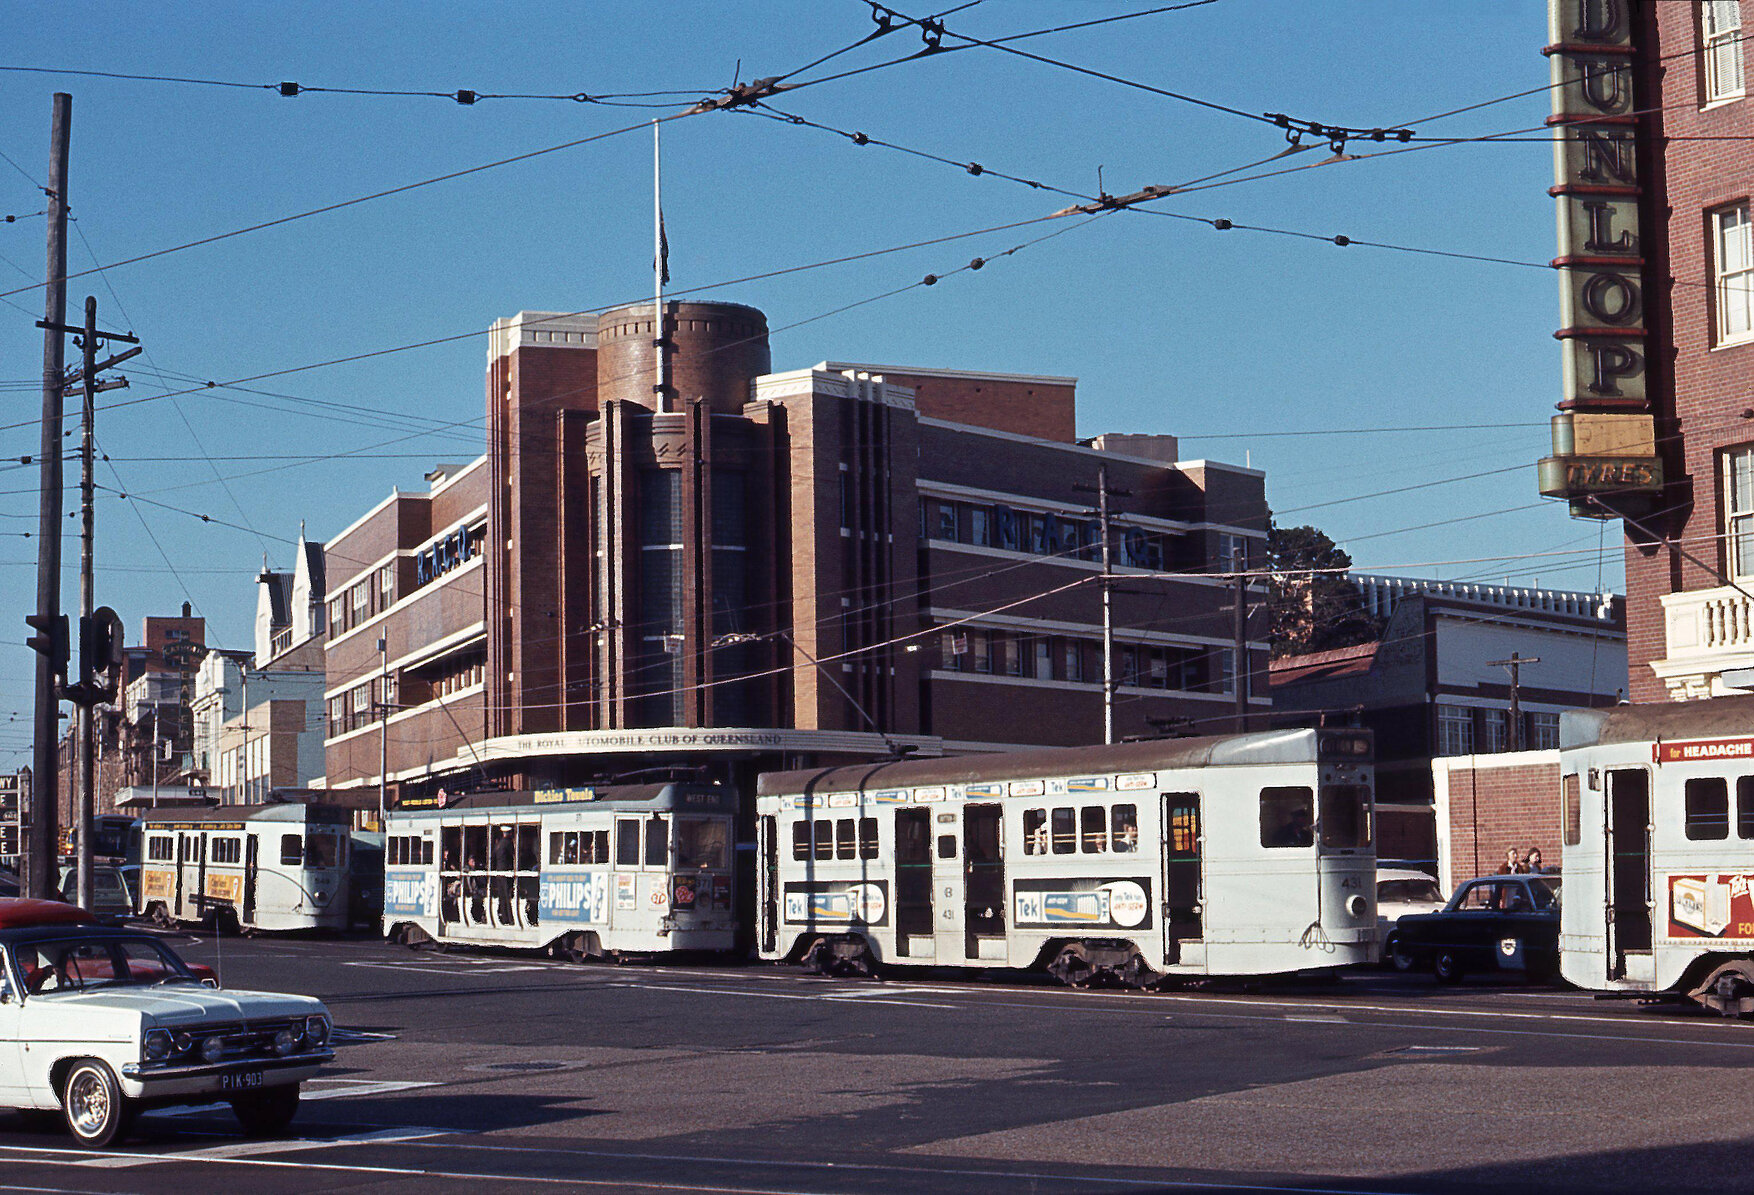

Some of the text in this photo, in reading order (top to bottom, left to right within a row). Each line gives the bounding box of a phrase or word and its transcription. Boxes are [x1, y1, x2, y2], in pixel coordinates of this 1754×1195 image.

[1573, 0, 1637, 396] DUNLOP
[1566, 462, 1654, 484] TYRES
[518, 741, 531, 751] THE
[537, 740, 564, 749] ROYAL
[649, 735, 679, 745] CLUB
[682, 735, 696, 745] OF
[703, 735, 782, 745] QUEENSLAND
[1669, 743, 1753, 758] for HEADACHE
[686, 793, 704, 802] WEST
[1342, 877, 1361, 889] 431
[393, 881, 425, 904] PHILIPS
[548, 882, 591, 910] PHILIPS
[787, 899, 803, 914] Tek
[1018, 898, 1038, 917] Tek
[943, 910, 955, 920] 431
[1738, 922, 1754, 935] FO
